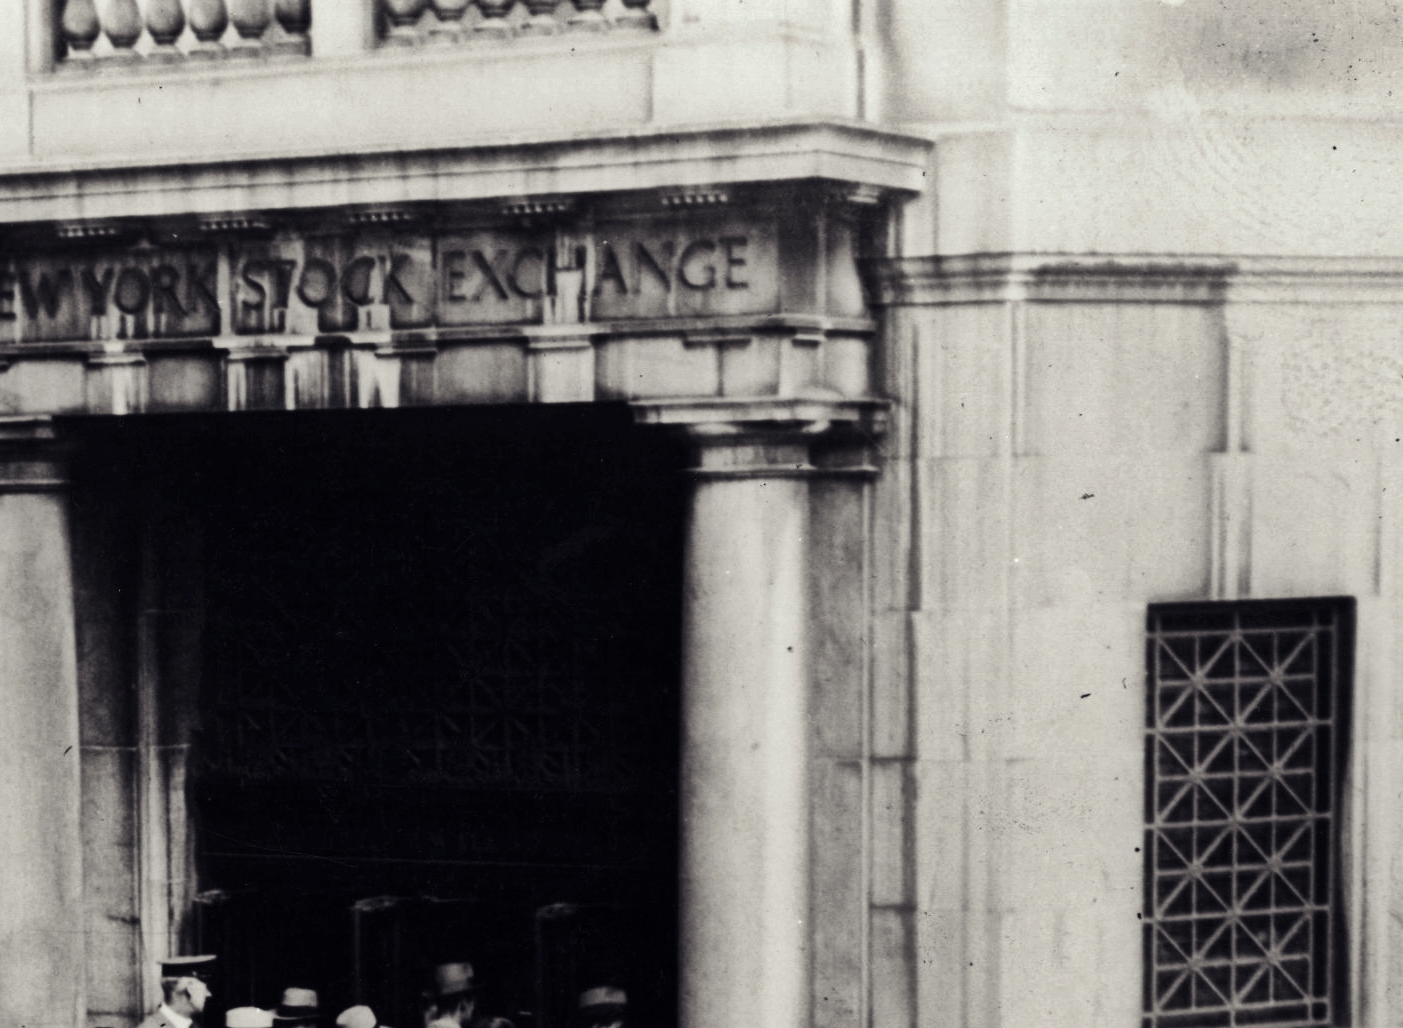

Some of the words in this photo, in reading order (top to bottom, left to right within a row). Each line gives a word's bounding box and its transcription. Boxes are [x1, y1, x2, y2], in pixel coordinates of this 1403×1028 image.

[81, 261, 221, 318] YORK
[239, 252, 414, 309] STOCK
[442, 235, 749, 301] EXCHANGE
